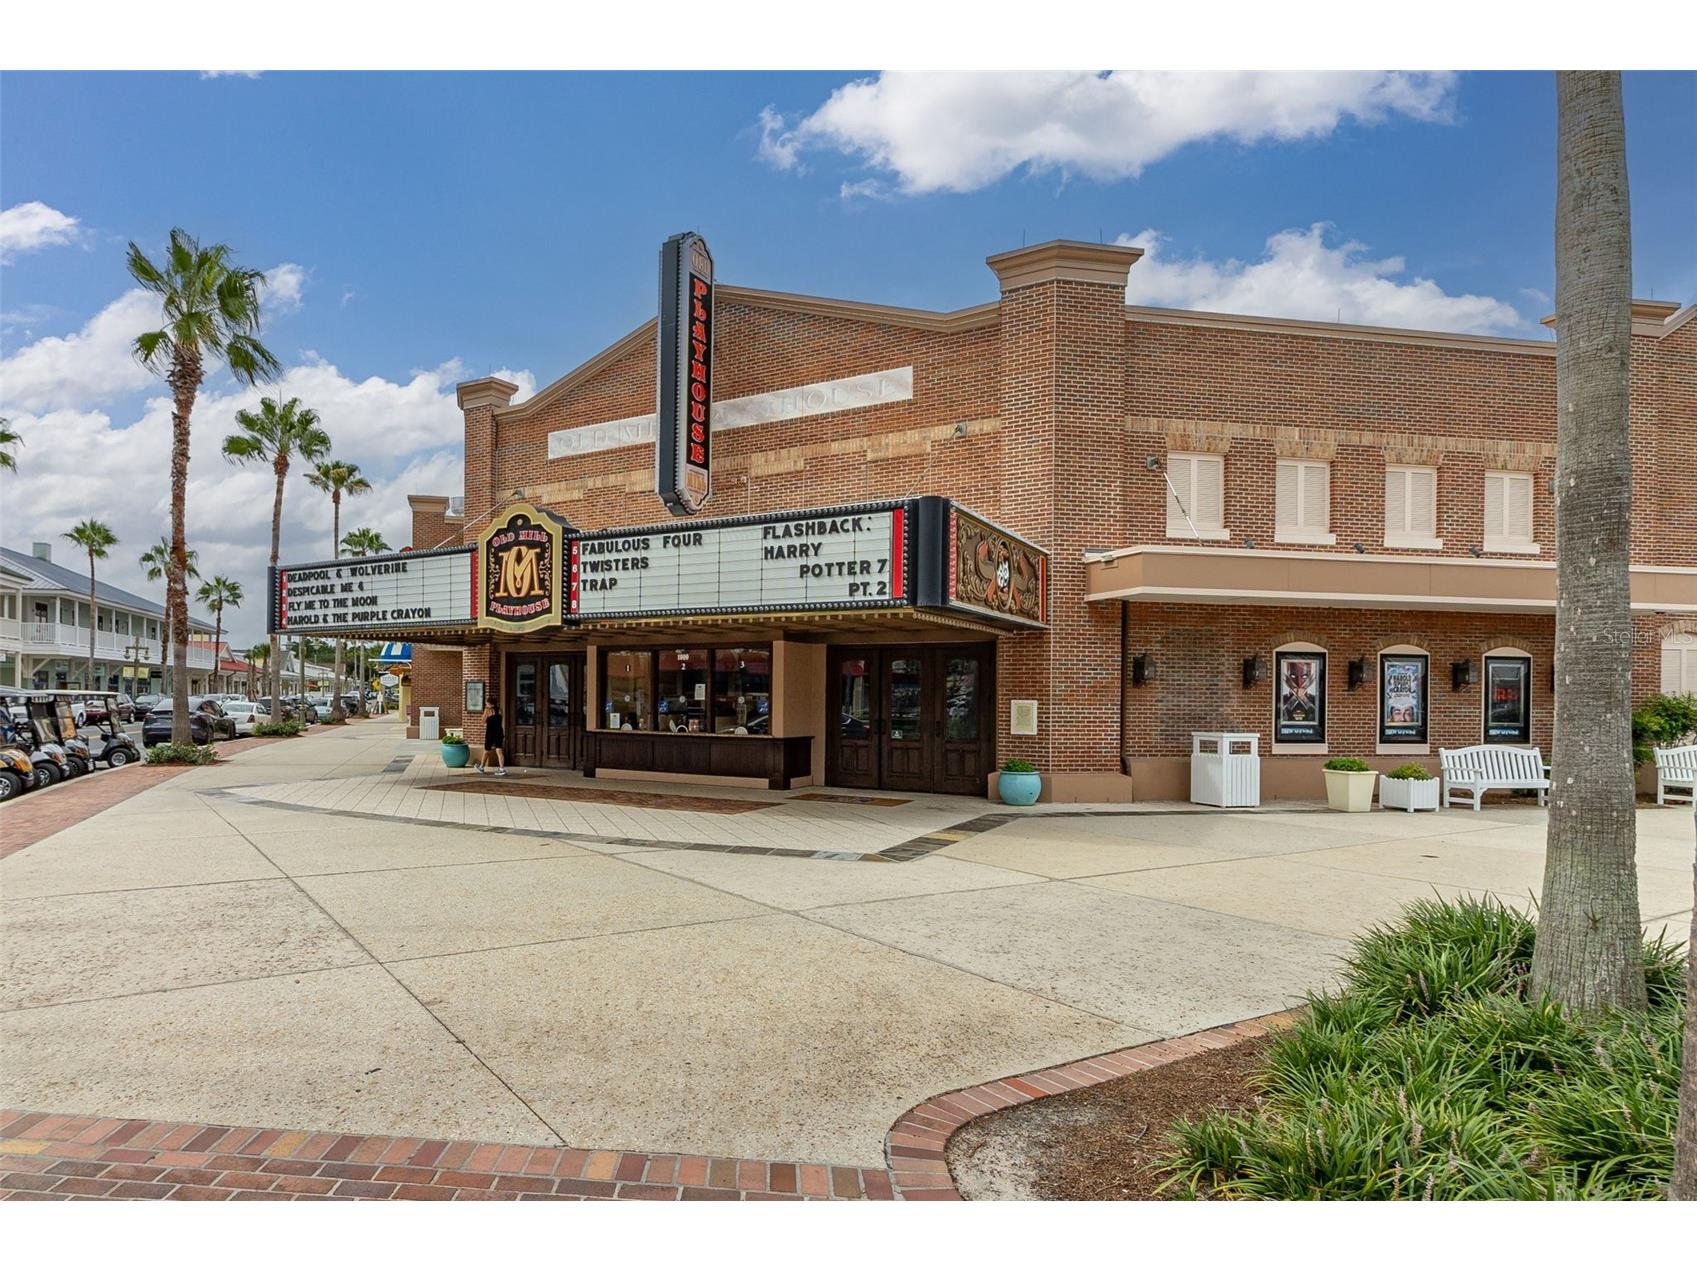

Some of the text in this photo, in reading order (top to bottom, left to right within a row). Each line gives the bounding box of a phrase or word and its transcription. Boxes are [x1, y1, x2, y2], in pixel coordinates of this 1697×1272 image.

[690, 278, 708, 464] PLAYHOUSE
[763, 516, 873, 540] FLASHBACK:
[491, 530, 549, 547] OLD MILL
[581, 537, 650, 556] FABULOUS
[663, 532, 703, 549] FOUR
[764, 542, 823, 560] HARRY
[287, 570, 330, 583] DEADPOOL
[350, 562, 408, 577] WOLVERINE
[581, 557, 649, 574] TWISTERS
[800, 559, 888, 578] POTTER 7
[287, 584, 335, 597] DESPICABLE
[340, 582, 354, 593] ME
[581, 578, 618, 592] TRAP
[848, 581, 887, 597] PT. 2
[288, 601, 302, 611] FLY
[304, 600, 316, 610] ME
[318, 599, 329, 609] TO
[332, 598, 348, 608] THE
[352, 595, 378, 607] MOON
[489, 598, 551, 616] PLAYHOUSE
[287, 614, 320, 625] HAROLD
[332, 612, 348, 623] THE
[352, 610, 388, 622] PURPLE
[391, 607, 432, 620] CRAYON
